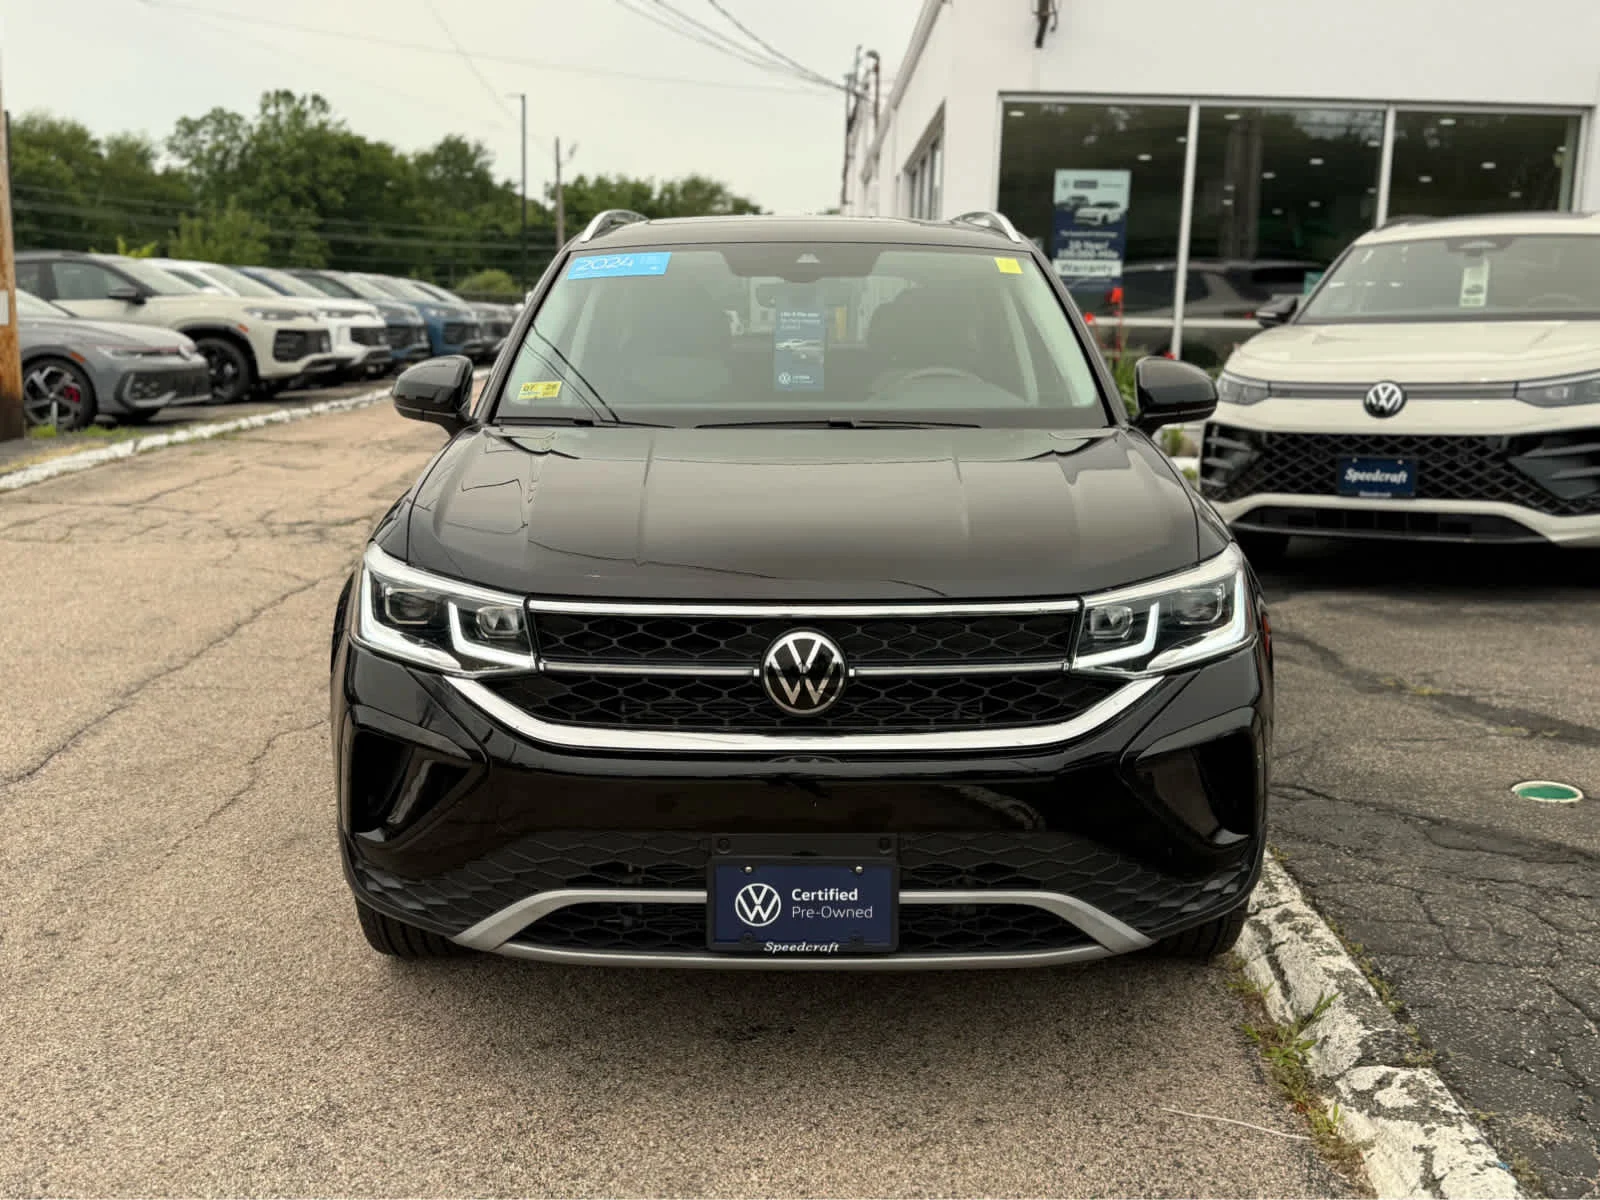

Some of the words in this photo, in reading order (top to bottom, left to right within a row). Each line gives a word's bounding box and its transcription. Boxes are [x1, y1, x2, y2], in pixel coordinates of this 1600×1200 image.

[575, 256, 634, 271] 2024
[1344, 467, 1408, 485] Speedcraft
[791, 888, 858, 901] Certified
[735, 883, 781, 926] VW
[791, 906, 873, 919] Pre-Owned
[763, 941, 840, 953] Speedcraft
